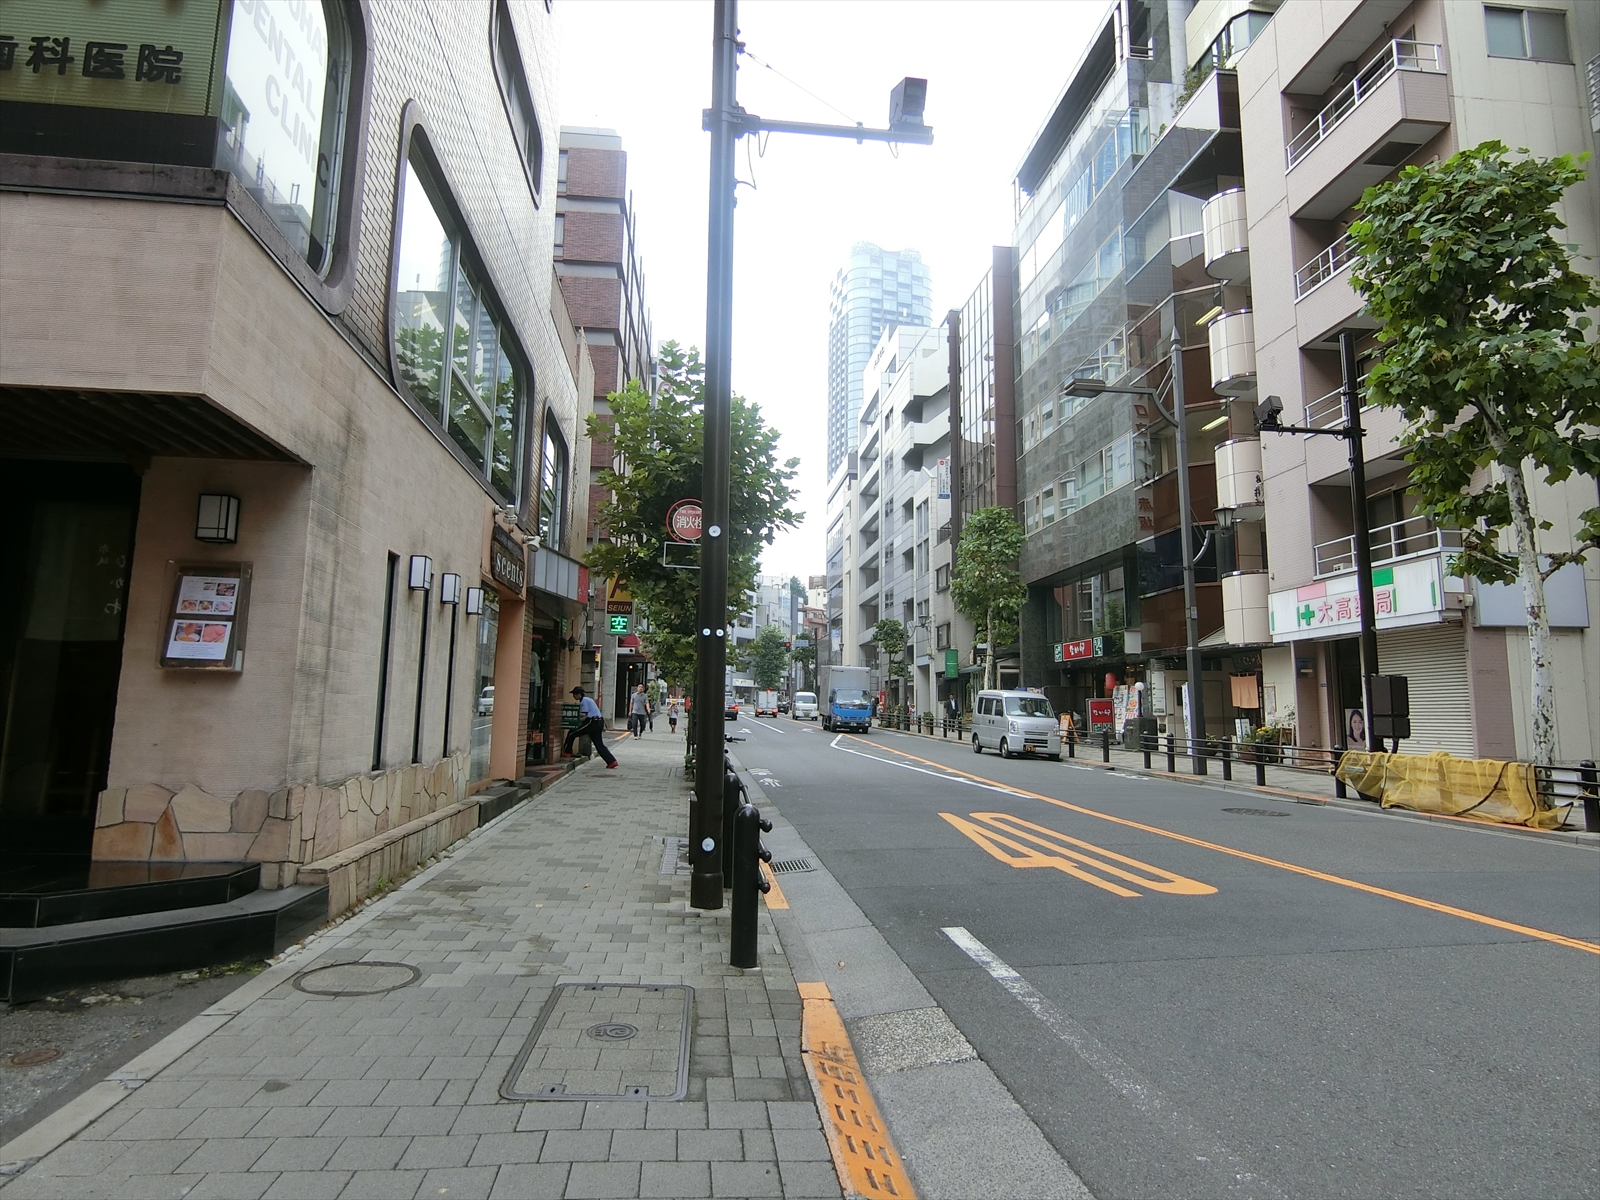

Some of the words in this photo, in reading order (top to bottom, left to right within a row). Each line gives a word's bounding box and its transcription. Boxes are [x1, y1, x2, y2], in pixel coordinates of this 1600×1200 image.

[676, 515, 702, 529] 消火栓
[607, 604, 632, 613] SEIUN
[611, 615, 628, 632] 空
[937, 811, 1219, 897] 40
